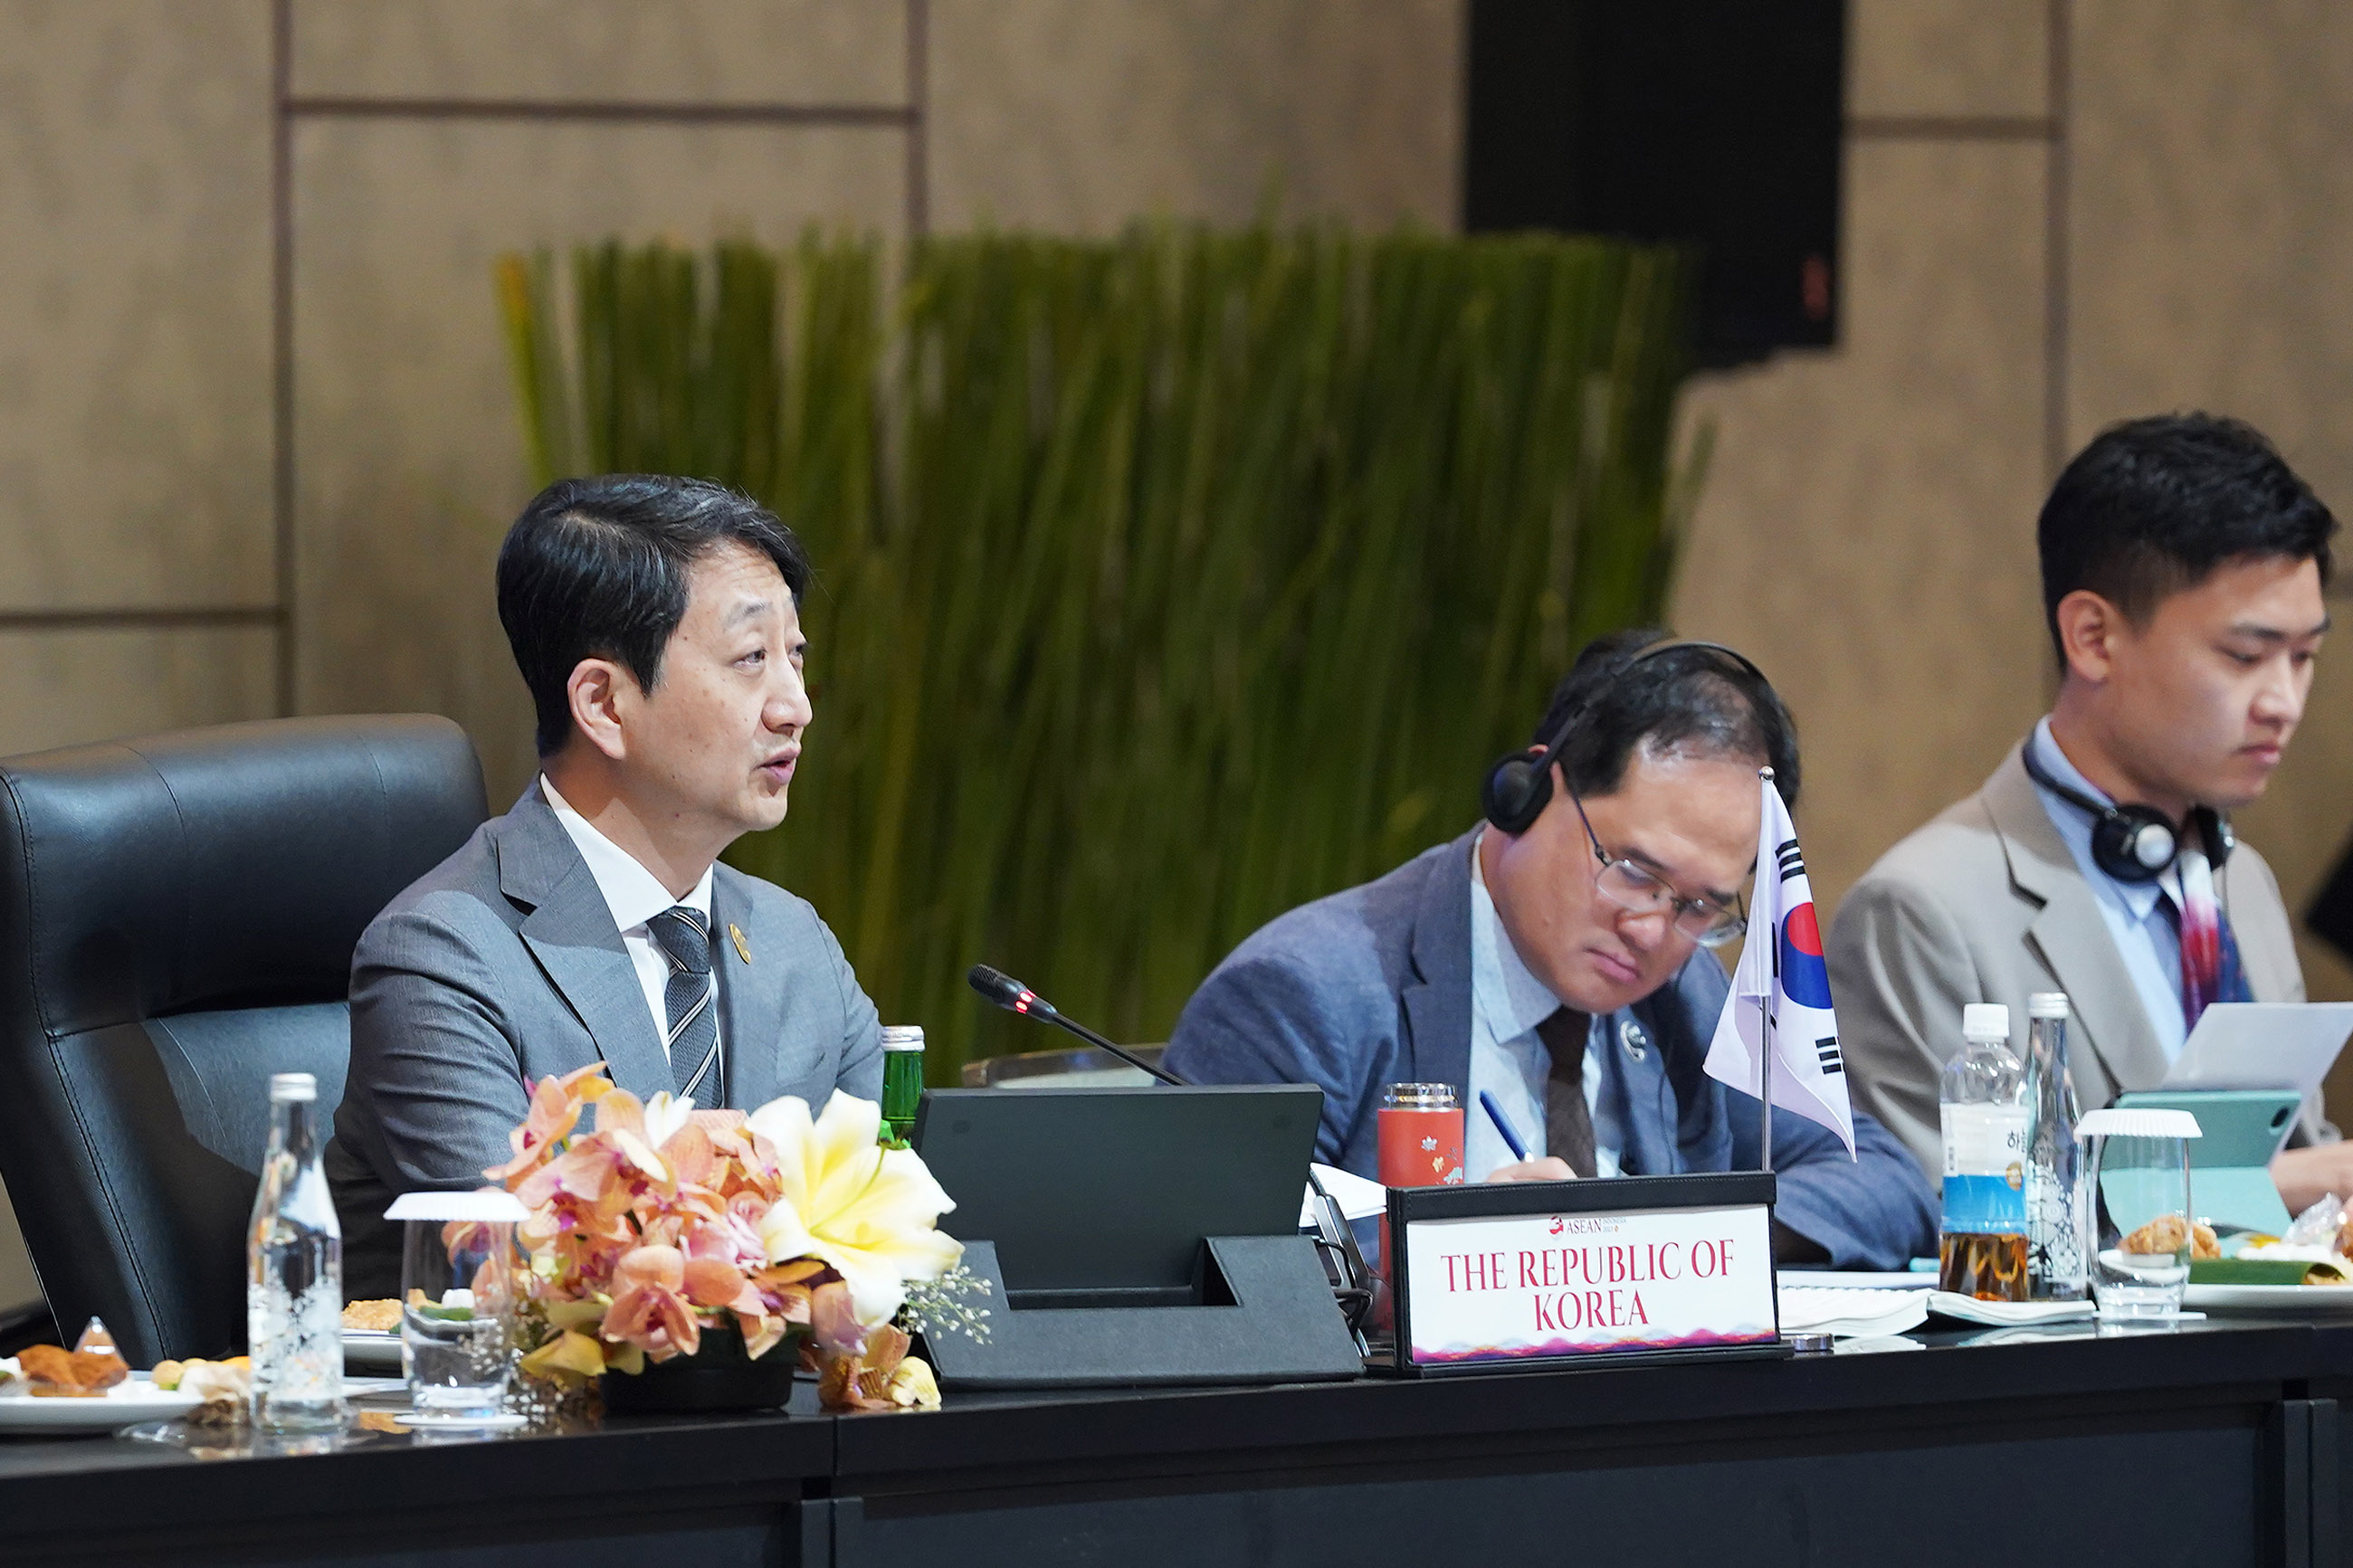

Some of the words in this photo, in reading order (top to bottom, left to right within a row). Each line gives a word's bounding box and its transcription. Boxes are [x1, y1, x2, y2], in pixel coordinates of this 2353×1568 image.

[1567, 1219, 1601, 1234] ASEAN
[1441, 1252, 1507, 1291] THE
[1519, 1242, 1681, 1288] REPUBLIC
[1691, 1239, 1734, 1278] OF
[1533, 1289, 1649, 1330] KOREA
